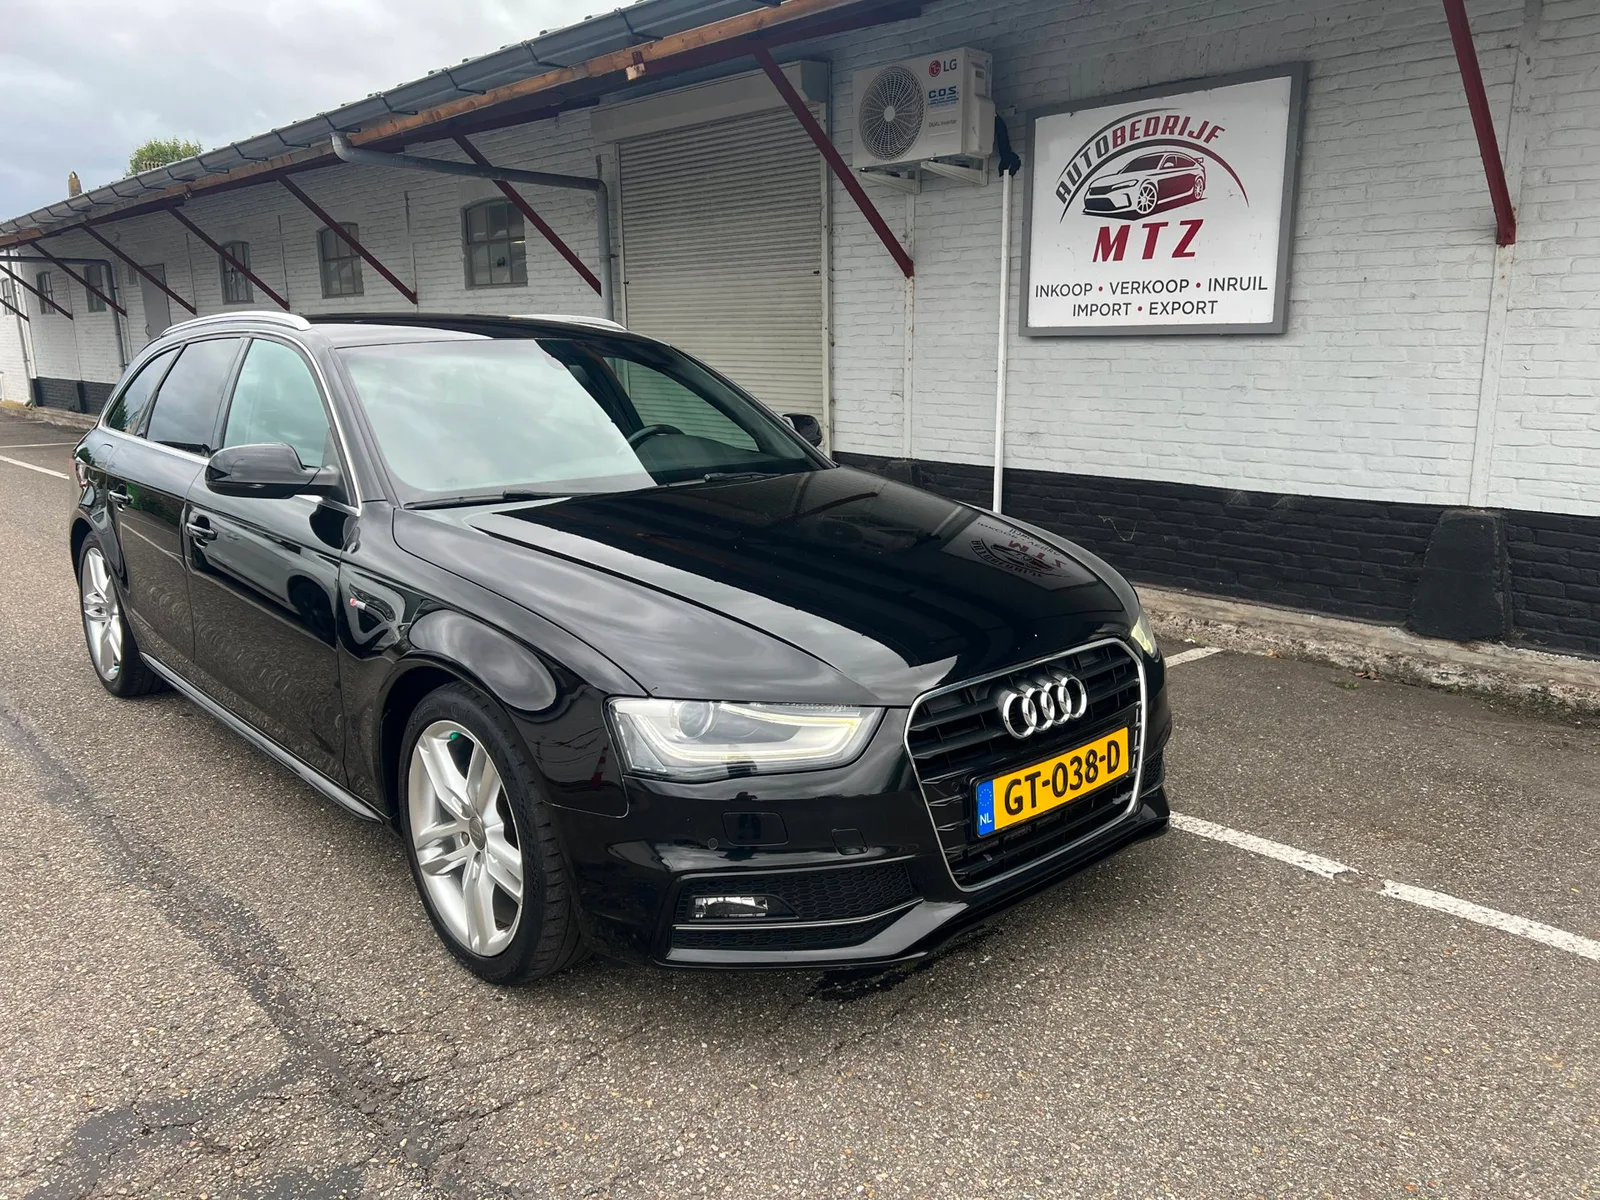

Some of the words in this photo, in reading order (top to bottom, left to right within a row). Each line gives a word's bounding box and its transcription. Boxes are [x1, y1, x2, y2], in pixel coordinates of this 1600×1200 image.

[943, 59, 957, 72] LG
[1055, 115, 1226, 205] AUTOBEDRIJF
[1092, 219, 1204, 263] MTZ
[1035, 283, 1093, 298] INKOOP
[1109, 279, 1190, 296] VERKOOP
[1208, 276, 1268, 292] INRUIL
[1072, 303, 1132, 317] IMPORT
[1149, 300, 1219, 316] EXPORT
[1004, 739, 1120, 816] GT-038-D
[979, 812, 993, 826] NL
